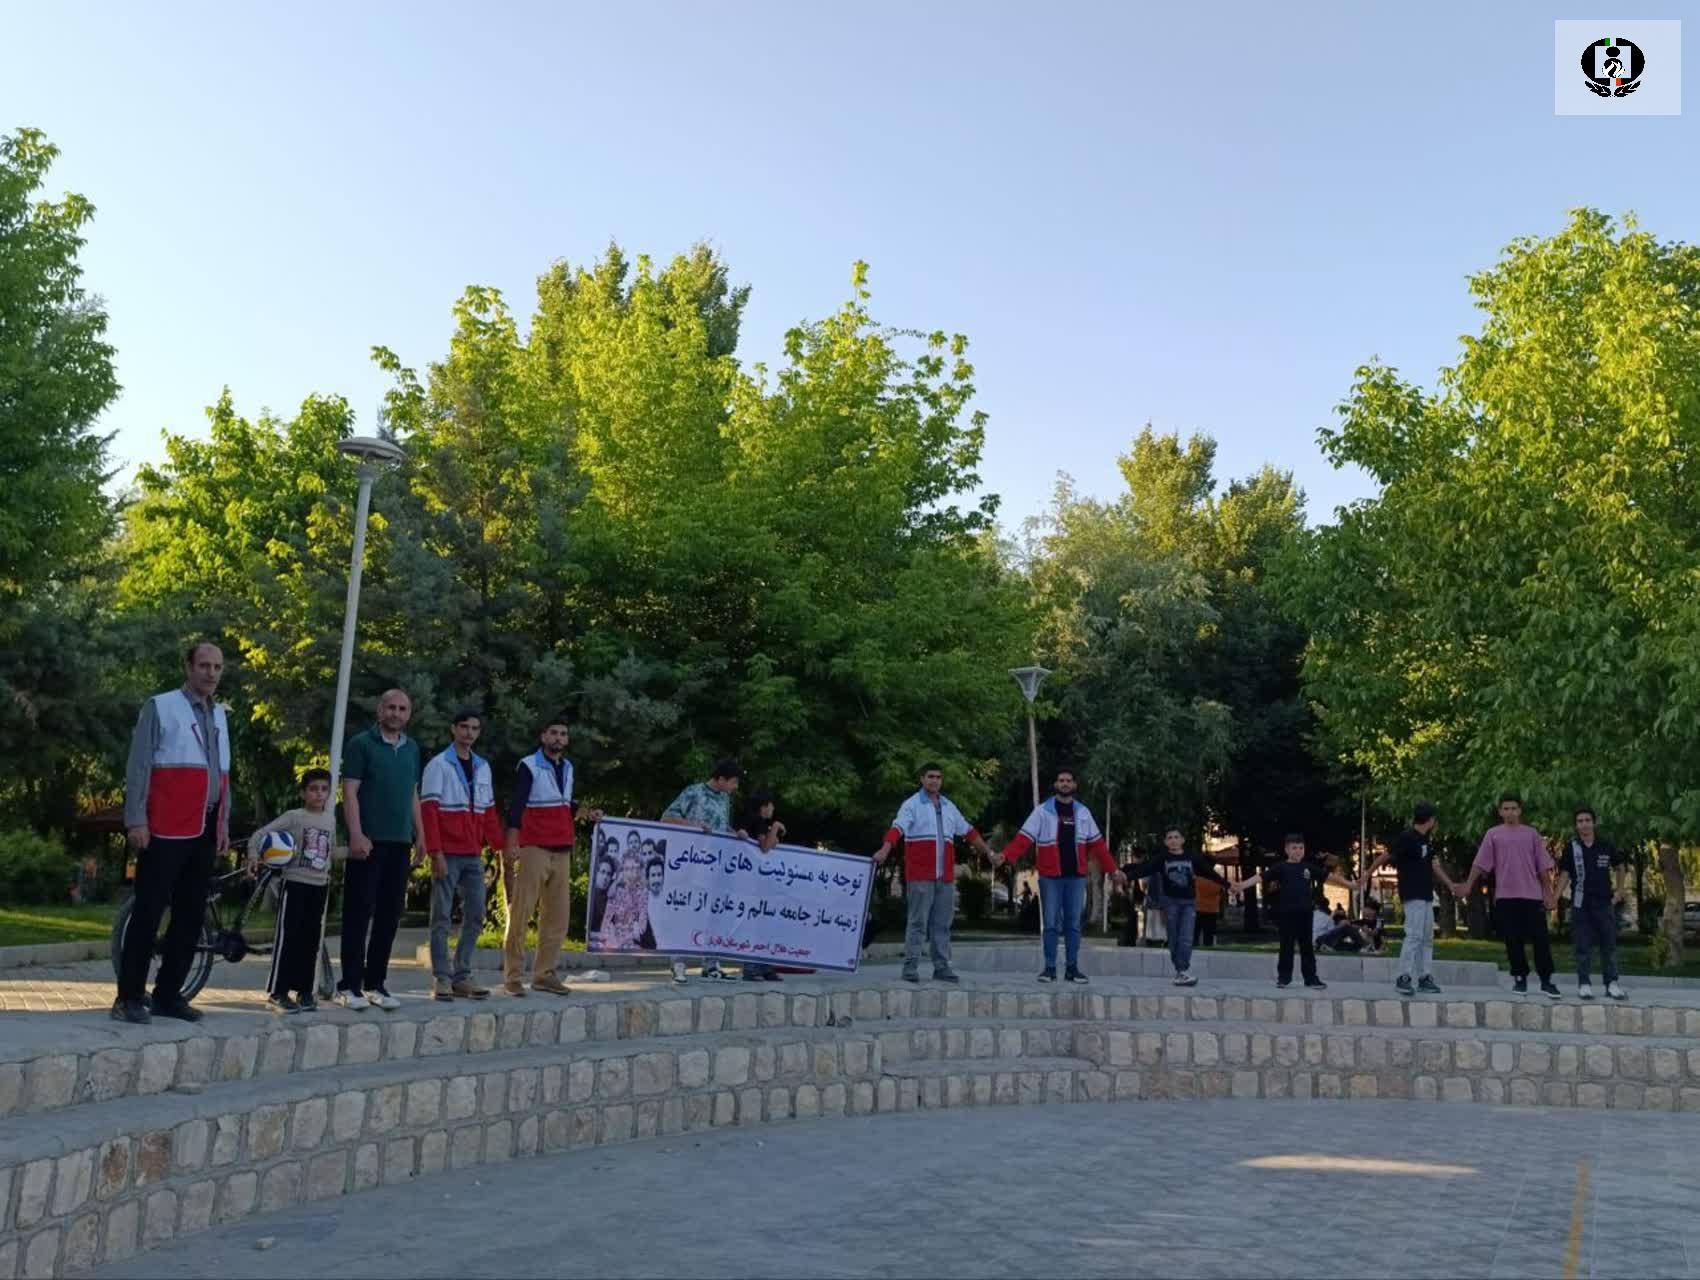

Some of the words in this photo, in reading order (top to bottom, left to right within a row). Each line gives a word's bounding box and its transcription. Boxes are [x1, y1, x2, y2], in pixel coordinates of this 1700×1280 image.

[668, 845, 722, 871] اجتماعی
[725, 852, 753, 873] های
[818, 870, 829, 889] به
[832, 872, 864, 896] توجه
[666, 889, 691, 911] اعتیاد
[694, 892, 708, 912] از
[710, 896, 734, 914] عاری
[736, 900, 745, 917] و
[747, 899, 776, 920] سالم
[779, 906, 811, 926] جامعه
[813, 907, 832, 926] ساز
[834, 914, 857, 932] زمینه
